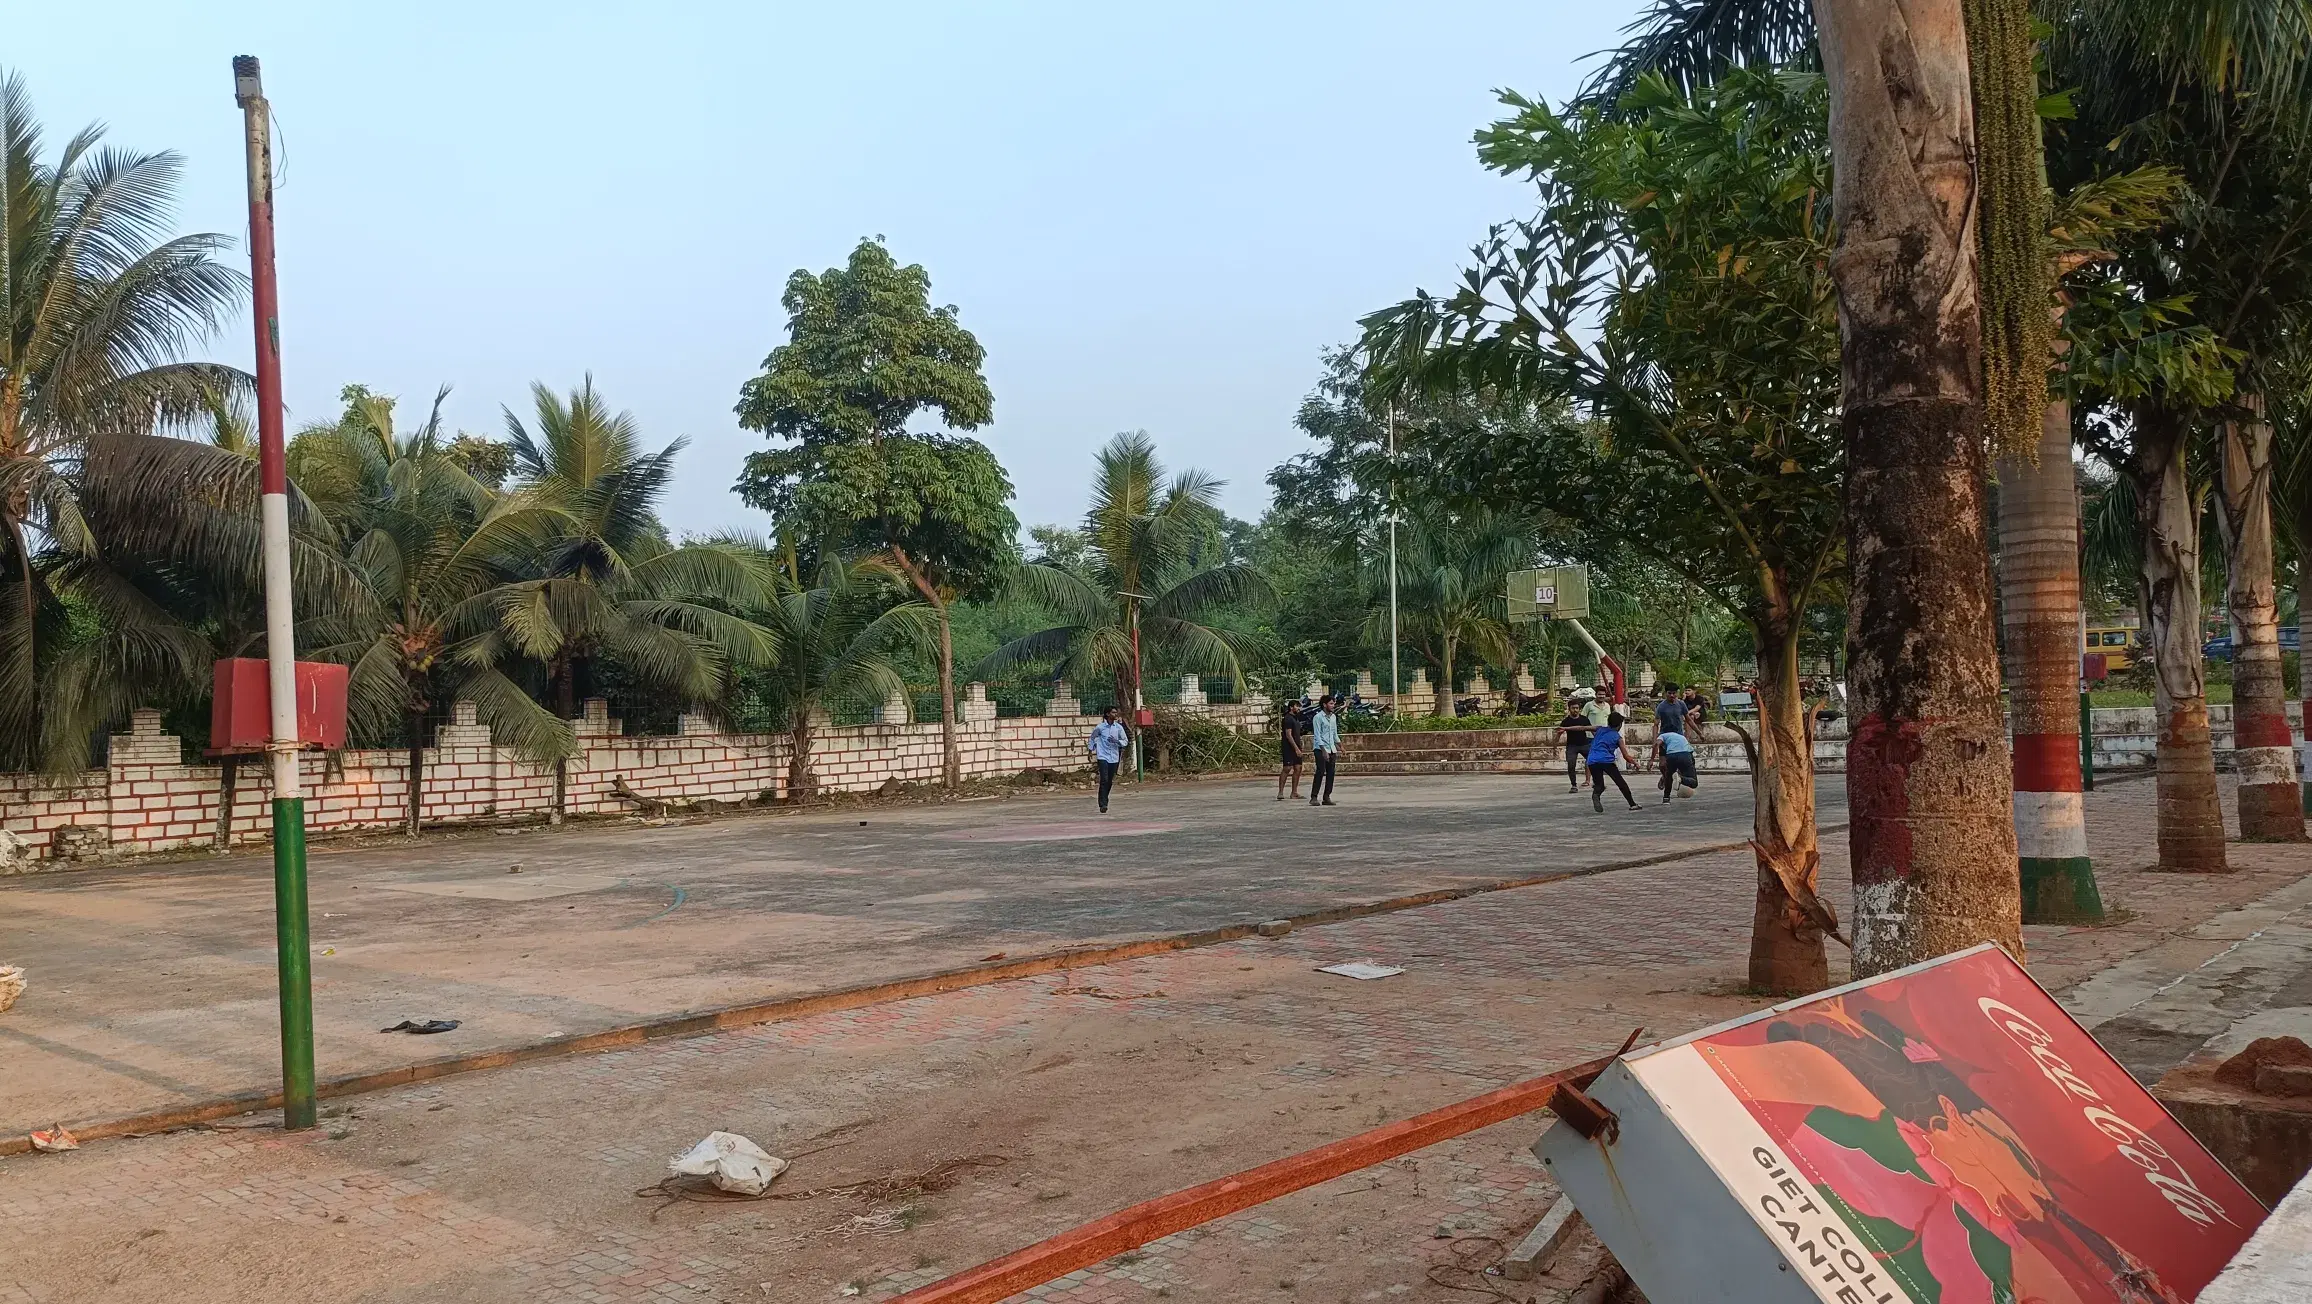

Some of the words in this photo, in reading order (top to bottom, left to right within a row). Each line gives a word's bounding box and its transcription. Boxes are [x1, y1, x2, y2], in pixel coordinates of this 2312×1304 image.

[1539, 588, 1553, 600] 10
[1714, 1055, 1752, 1098] CARBONATED
[1819, 1176, 1858, 1220] REGISTERED
[1857, 1220, 1896, 1265] TRADEMARK
[1896, 1265, 1907, 1276] OF
[1907, 1277, 1920, 1292] THE
[1752, 1146, 1821, 1215] GIET
[1978, 996, 2242, 1229] Coca-Cola
